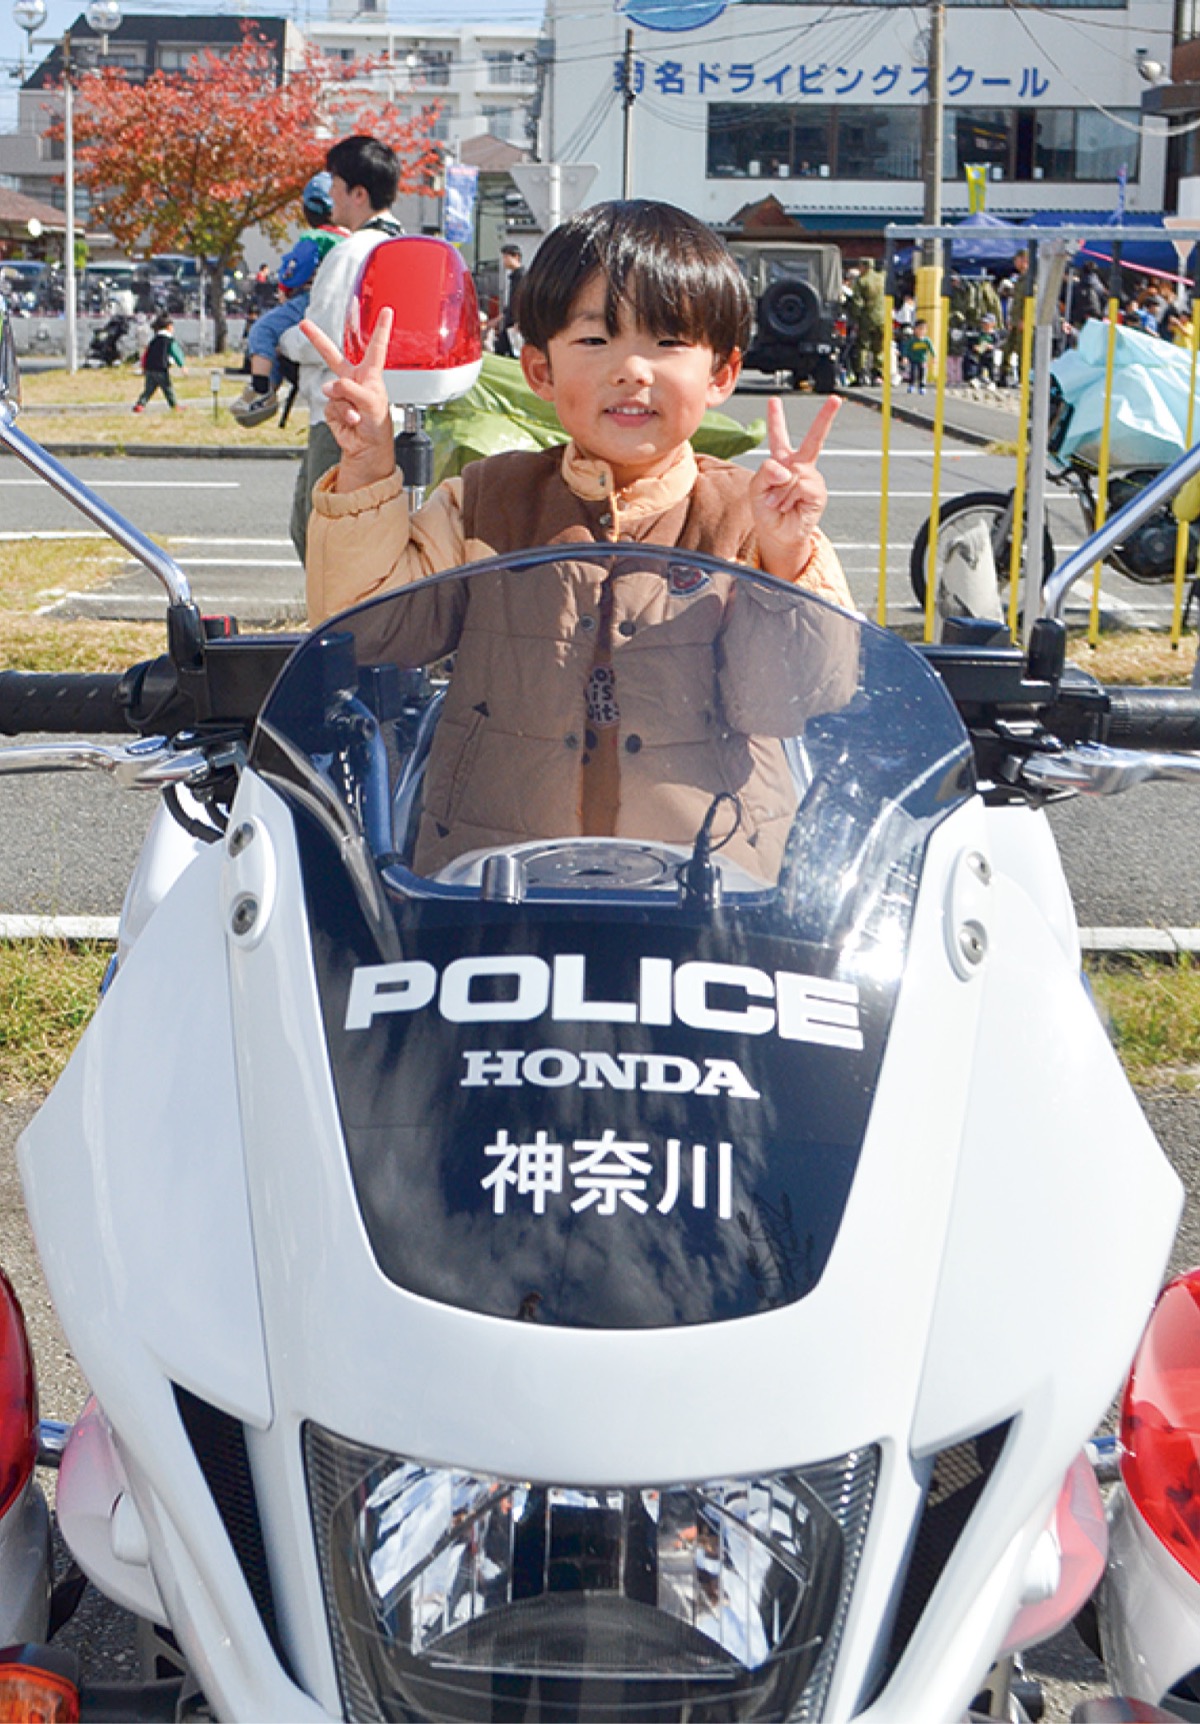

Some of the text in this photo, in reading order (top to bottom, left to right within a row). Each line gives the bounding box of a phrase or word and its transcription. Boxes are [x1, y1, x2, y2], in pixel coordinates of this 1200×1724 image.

[345, 954, 864, 1051] POLICE
[460, 1049, 760, 1100] HONDA
[481, 1130, 733, 1219] 神奈川
